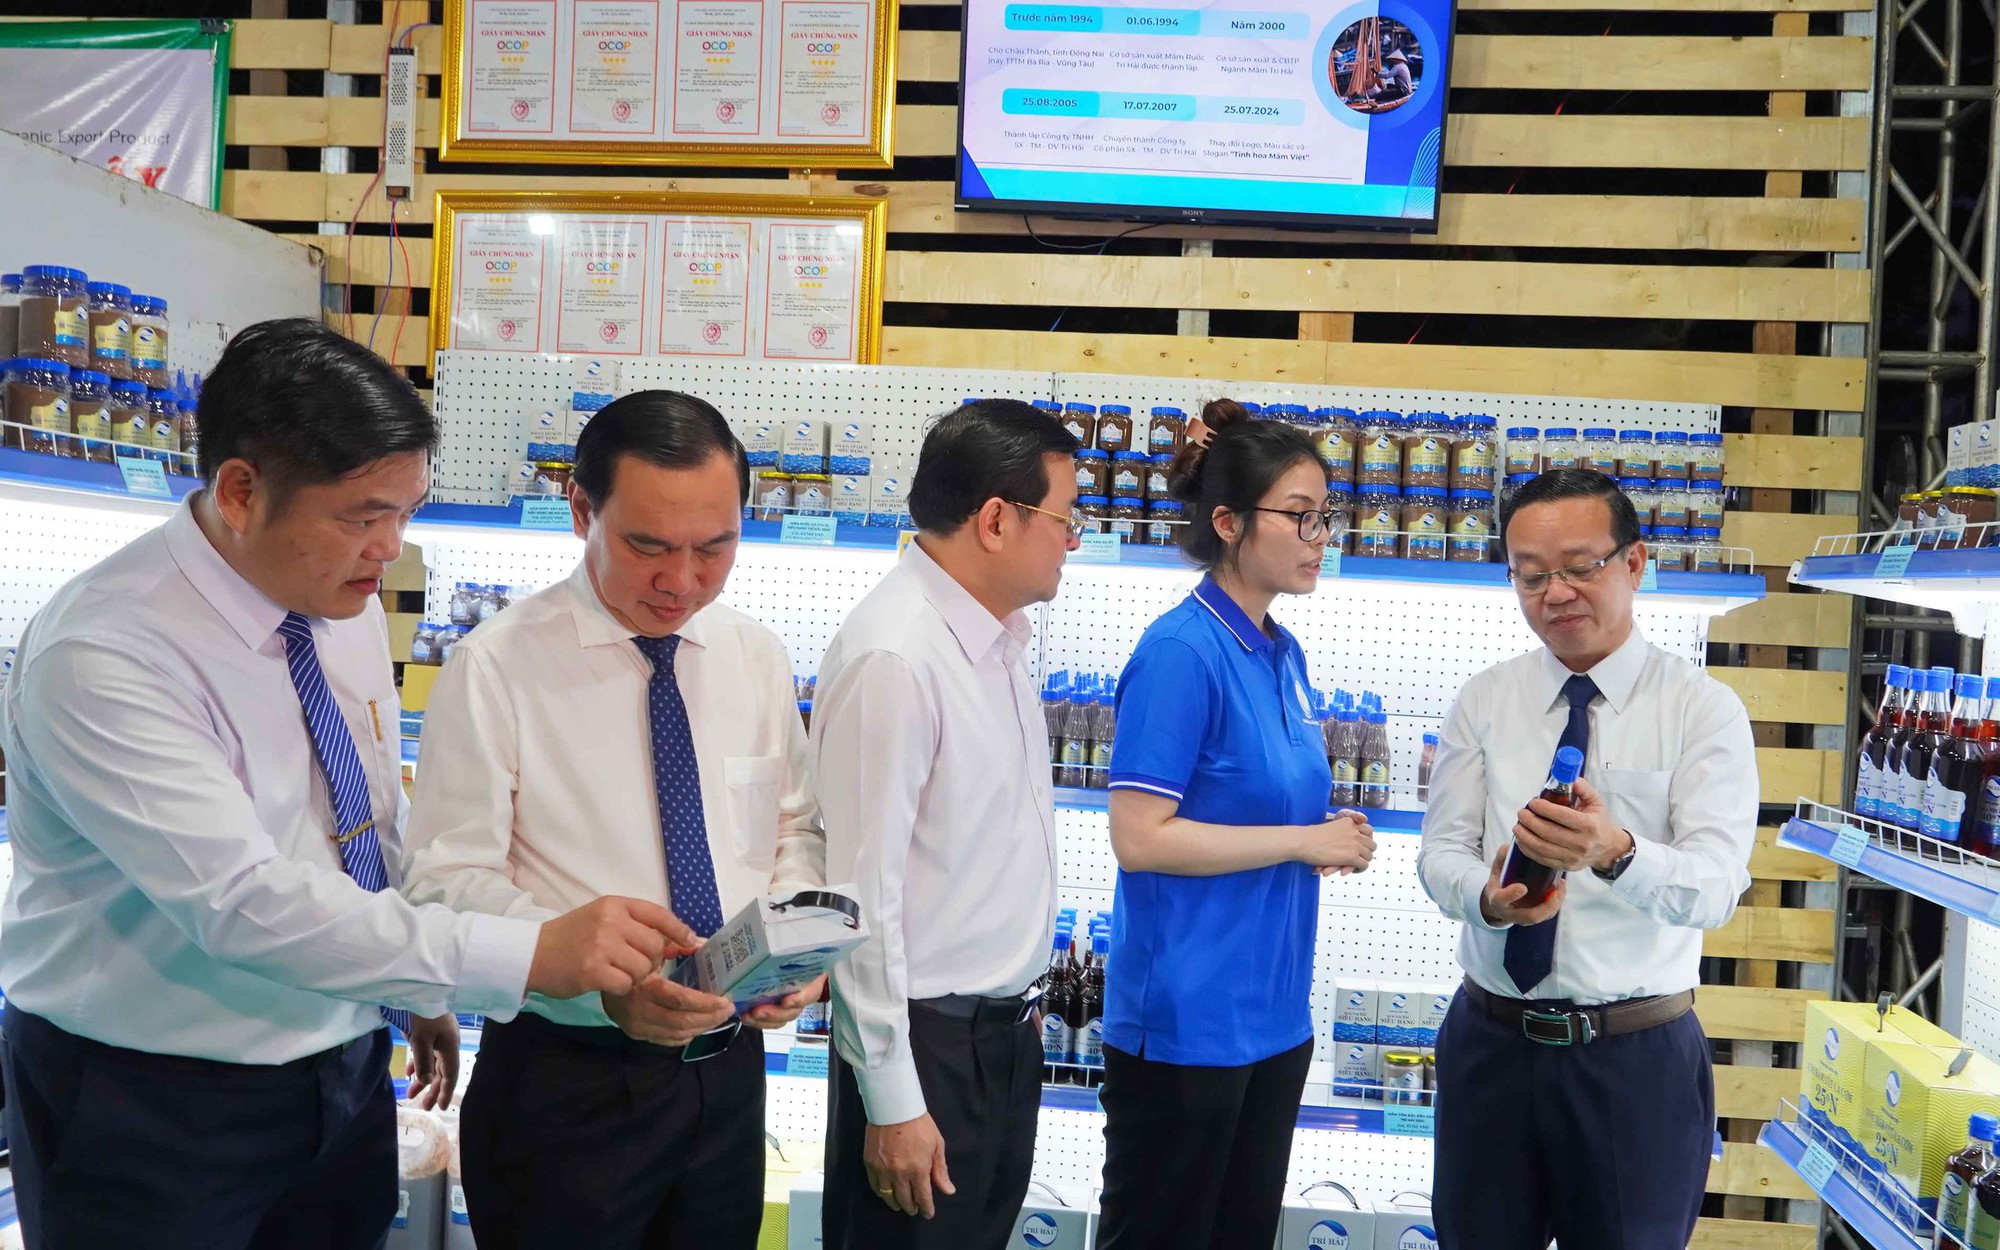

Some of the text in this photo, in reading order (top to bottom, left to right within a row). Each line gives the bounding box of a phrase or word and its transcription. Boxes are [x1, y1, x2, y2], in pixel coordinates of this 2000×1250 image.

[1011, 12, 1093, 24] Trước năm 1994
[1126, 16, 1179, 27] 01.06.1994
[1231, 20, 1286, 31] Năm 2000
[497, 40, 530, 50] OCOP
[599, 41, 632, 50] OCOP
[702, 41, 736, 51] OCOP
[807, 43, 841, 53] OCOP
[1022, 97, 1078, 108] 25.08.2005
[1123, 101, 1178, 112] 17.07.2007
[1224, 105, 1280, 116] 25.07.2024
[58, 130, 102, 146] Export
[110, 130, 170, 145] Product
[1202, 150, 1229, 158] Slogan
[486, 260, 518, 271] OCOP
[586, 262, 619, 272] OCOP
[689, 262, 722, 272] OCOP
[794, 266, 828, 276] OCOP
[1311, 1236, 1326, 1245] TRÍ
